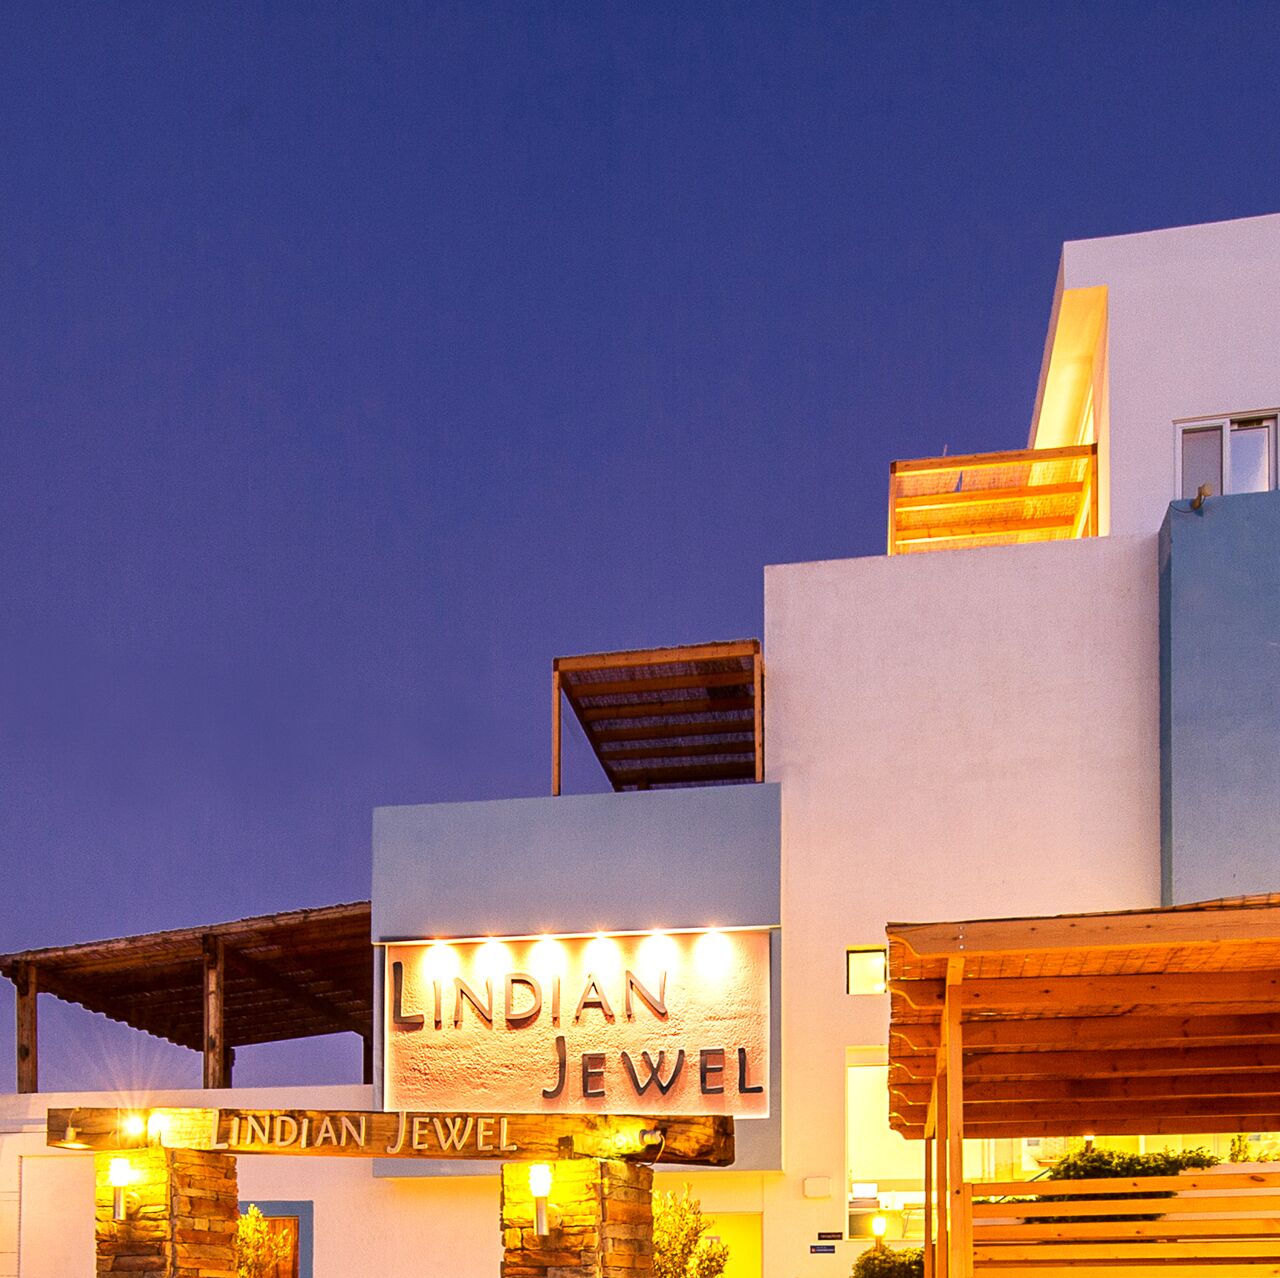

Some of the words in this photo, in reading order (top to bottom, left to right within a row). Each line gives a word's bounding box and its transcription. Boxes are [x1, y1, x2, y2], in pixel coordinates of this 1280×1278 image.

[392, 961, 668, 1029] LINDIAN
[542, 1035, 764, 1099] JEWEL
[210, 1109, 366, 1149] LINDIAN
[386, 1110, 518, 1153] JEWEL
